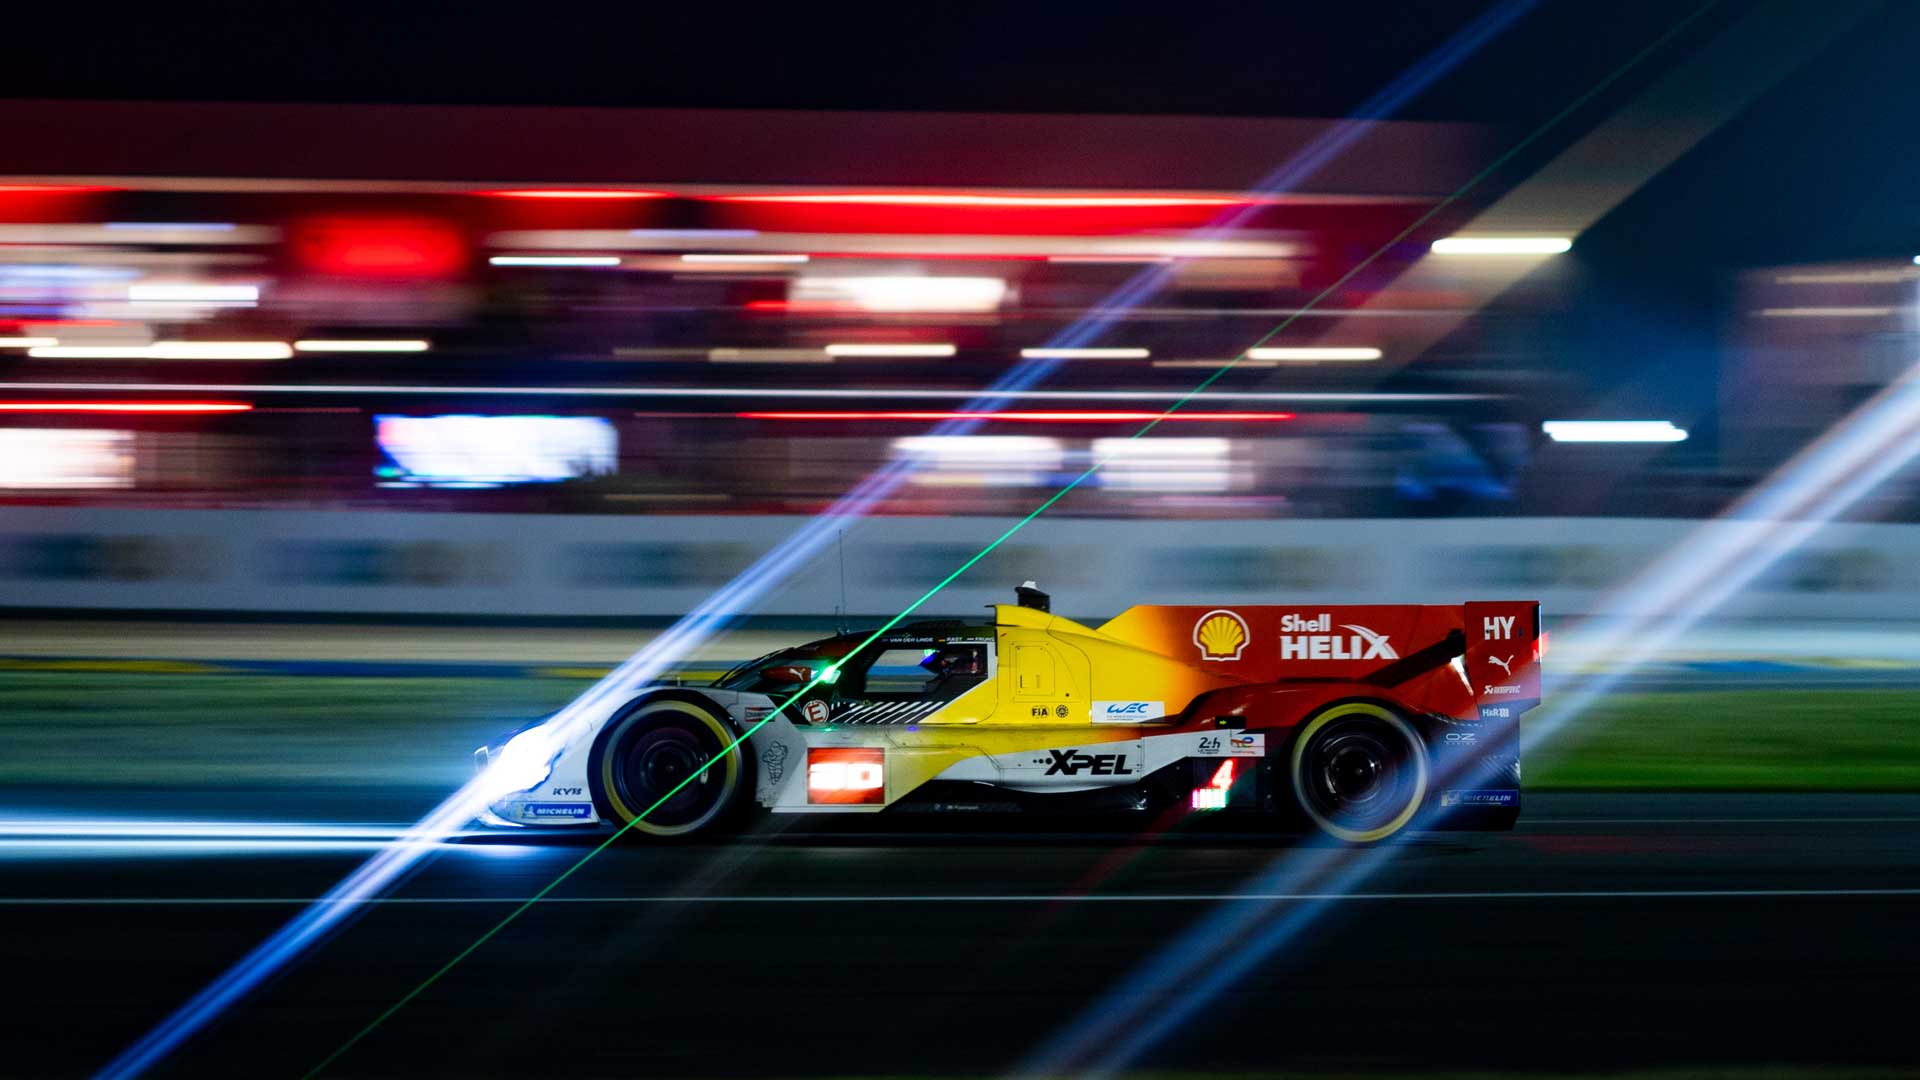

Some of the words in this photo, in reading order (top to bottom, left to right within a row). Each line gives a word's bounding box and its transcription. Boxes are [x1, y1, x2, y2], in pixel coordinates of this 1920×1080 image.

[1280, 613, 1331, 632] Shell
[1483, 615, 1516, 641] HY
[1279, 625, 1400, 660] HELIX
[1032, 708, 1048, 717] FIA
[1107, 702, 1149, 714] WEC
[1445, 733, 1476, 741] OZ
[1044, 749, 1132, 775] XPEL
